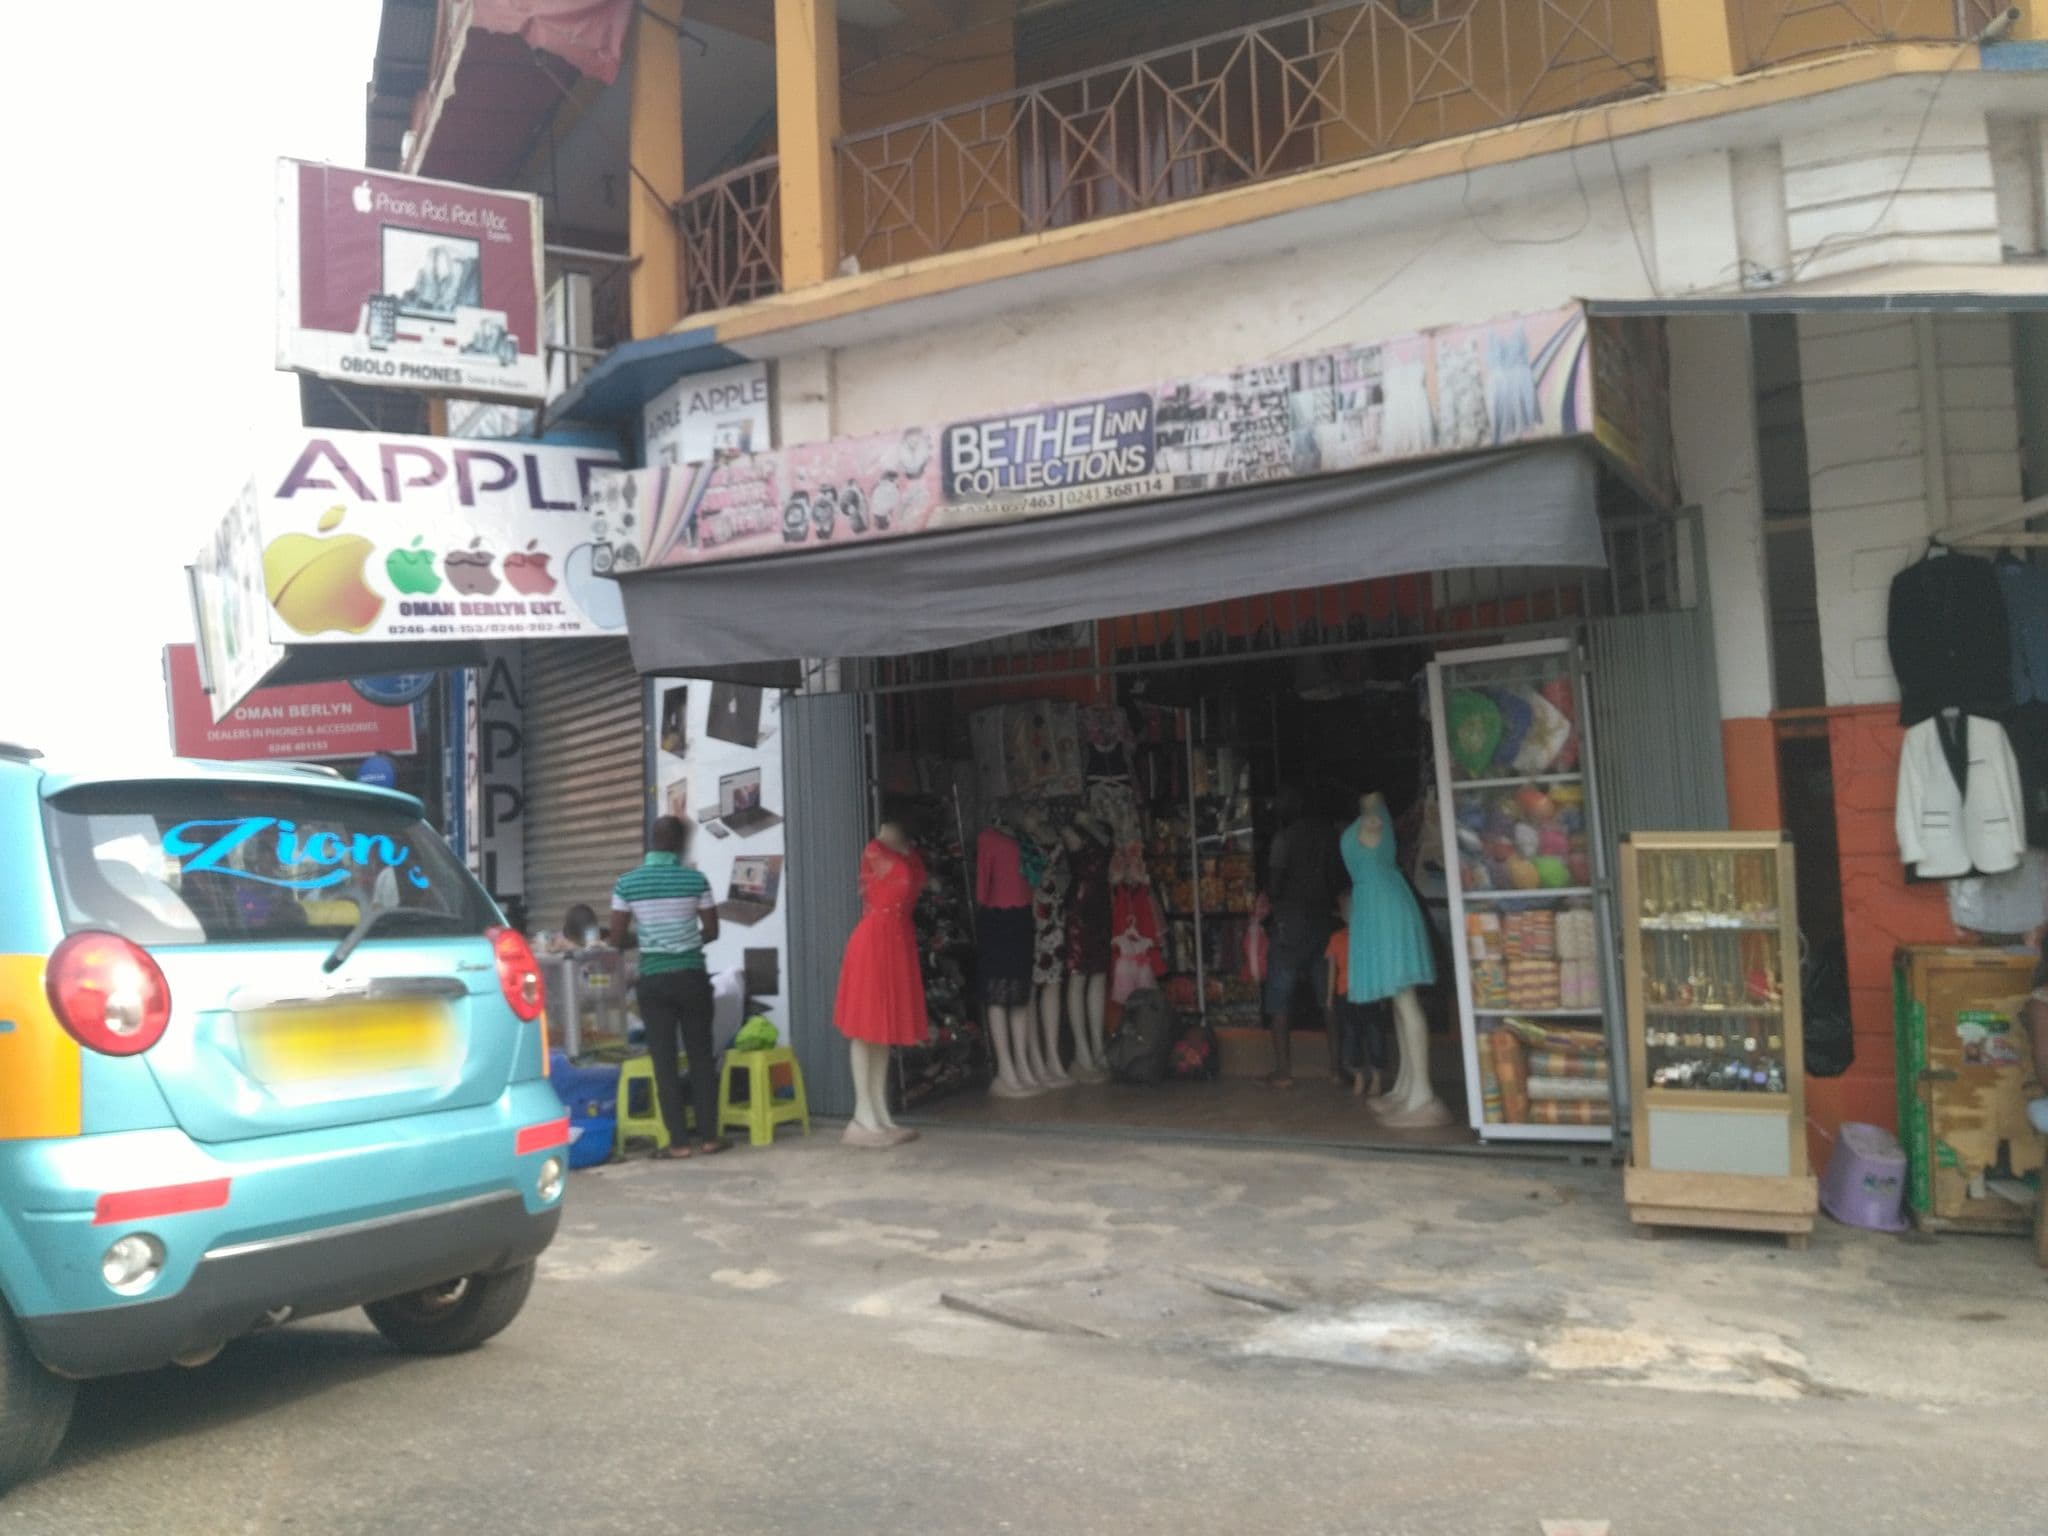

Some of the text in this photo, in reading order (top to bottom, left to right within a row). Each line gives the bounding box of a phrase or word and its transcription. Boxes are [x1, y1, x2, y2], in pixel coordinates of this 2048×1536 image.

[340, 355, 396, 378] OBOLO
[400, 361, 463, 384] PHONES
[687, 377, 768, 417] APPLE
[950, 404, 1118, 474] BETHEL
[953, 444, 1147, 499] COLLECTIONS
[1103, 479, 1163, 499] 368114
[399, 601, 456, 617] OMAN
[460, 601, 528, 617] BERLYN
[234, 702, 353, 721] OMAN BERLYN
[207, 728, 252, 742] DEALERS
[253, 728, 264, 738] IN
[265, 726, 305, 738] PHONES
[316, 721, 379, 735] ACCESSORIES
